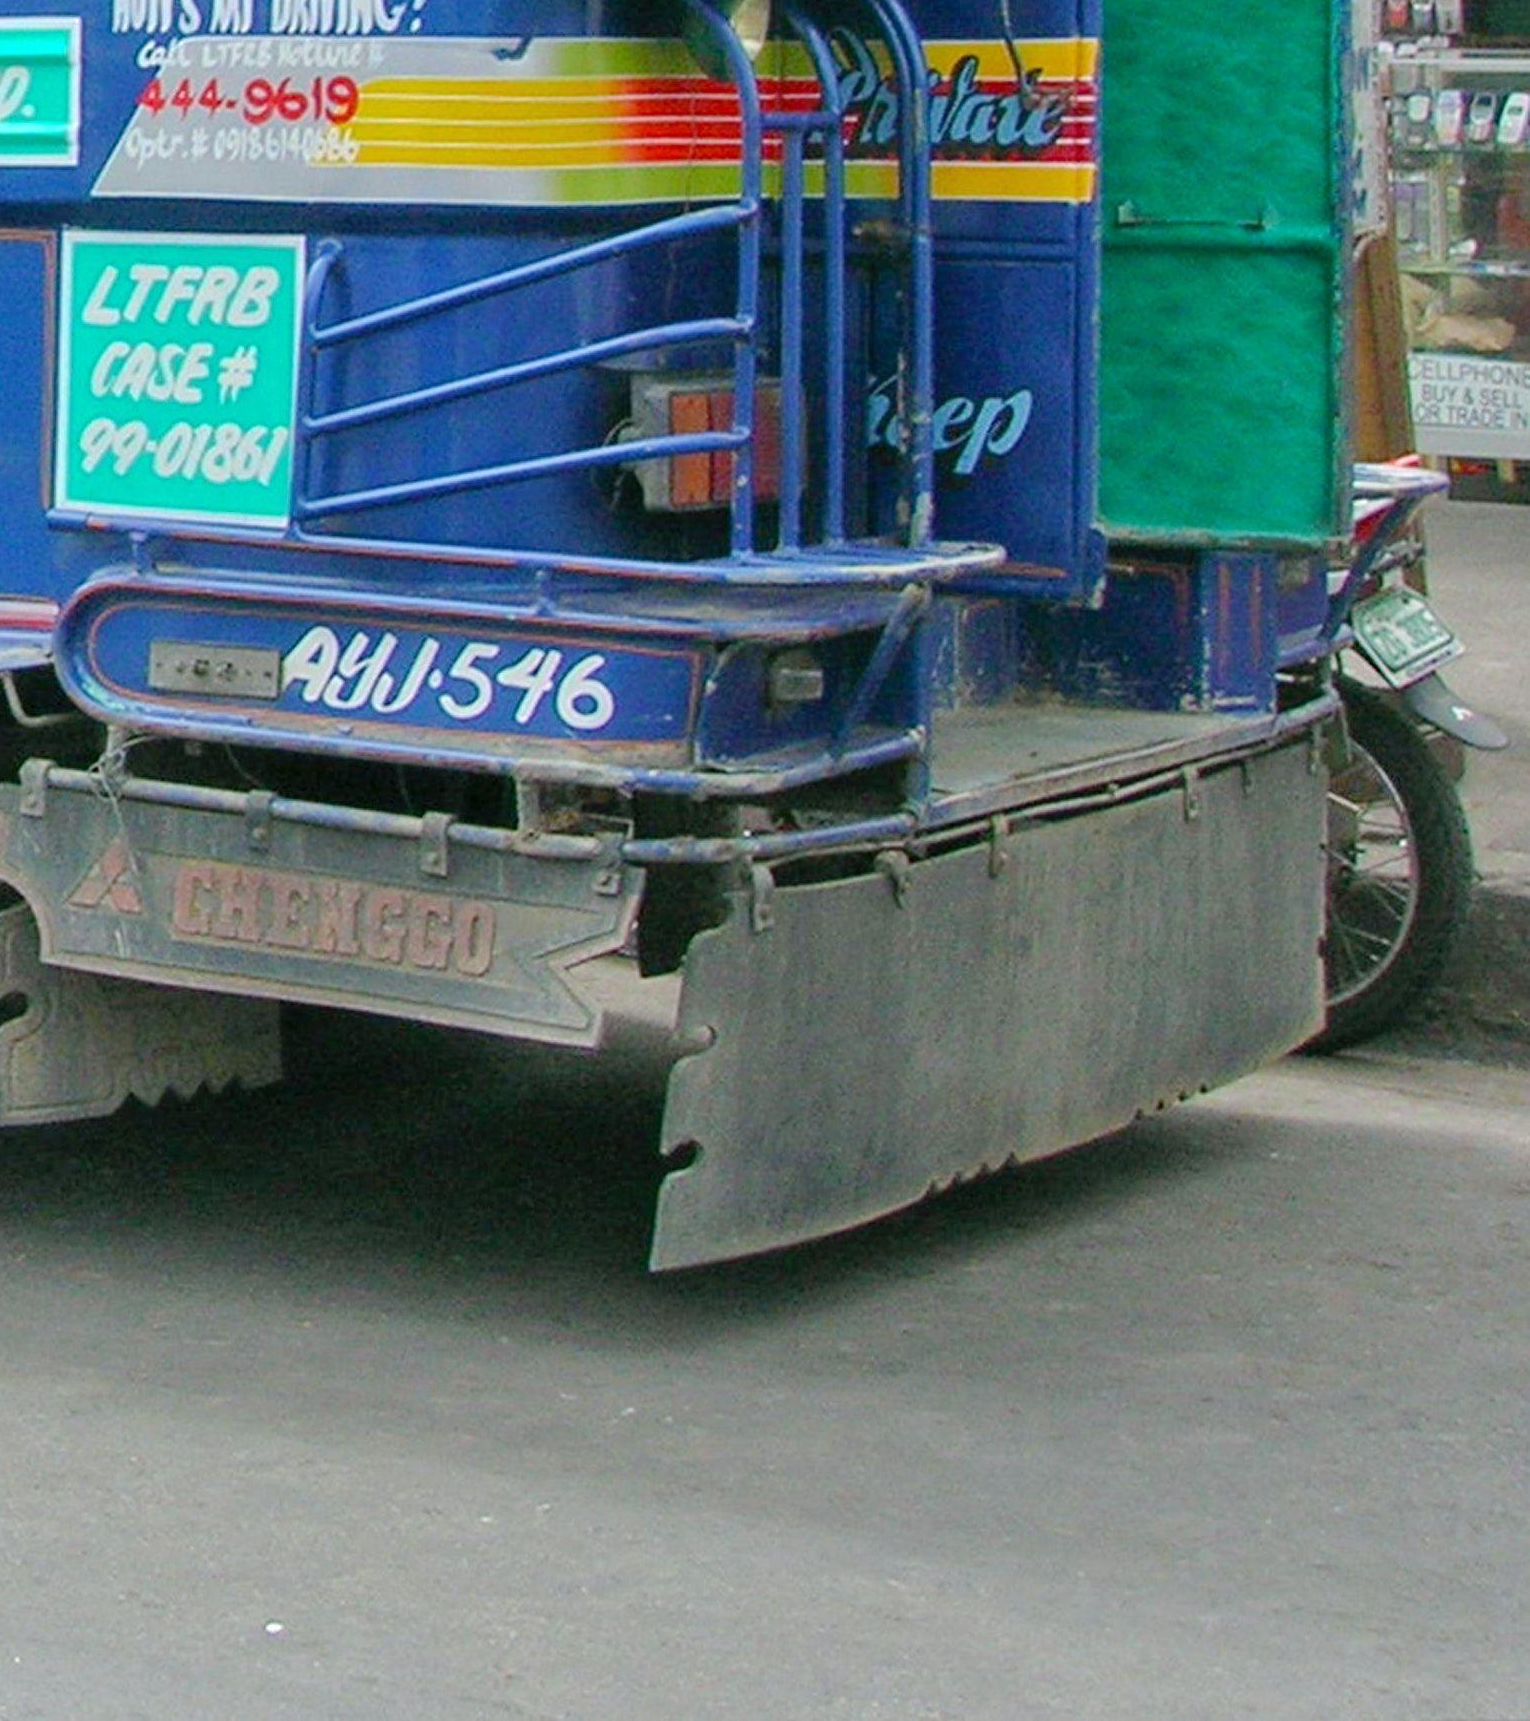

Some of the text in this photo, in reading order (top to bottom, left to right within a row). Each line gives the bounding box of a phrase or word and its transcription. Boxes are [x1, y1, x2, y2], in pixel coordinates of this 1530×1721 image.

[137, 39, 192, 69] Call
[81, 263, 280, 327] LTFRB
[90, 340, 258, 406] CASE #
[1421, 383, 1522, 409] BUY & SELL
[1447, 404, 1504, 429] TRADE
[79, 417, 289, 487] 99-01861
